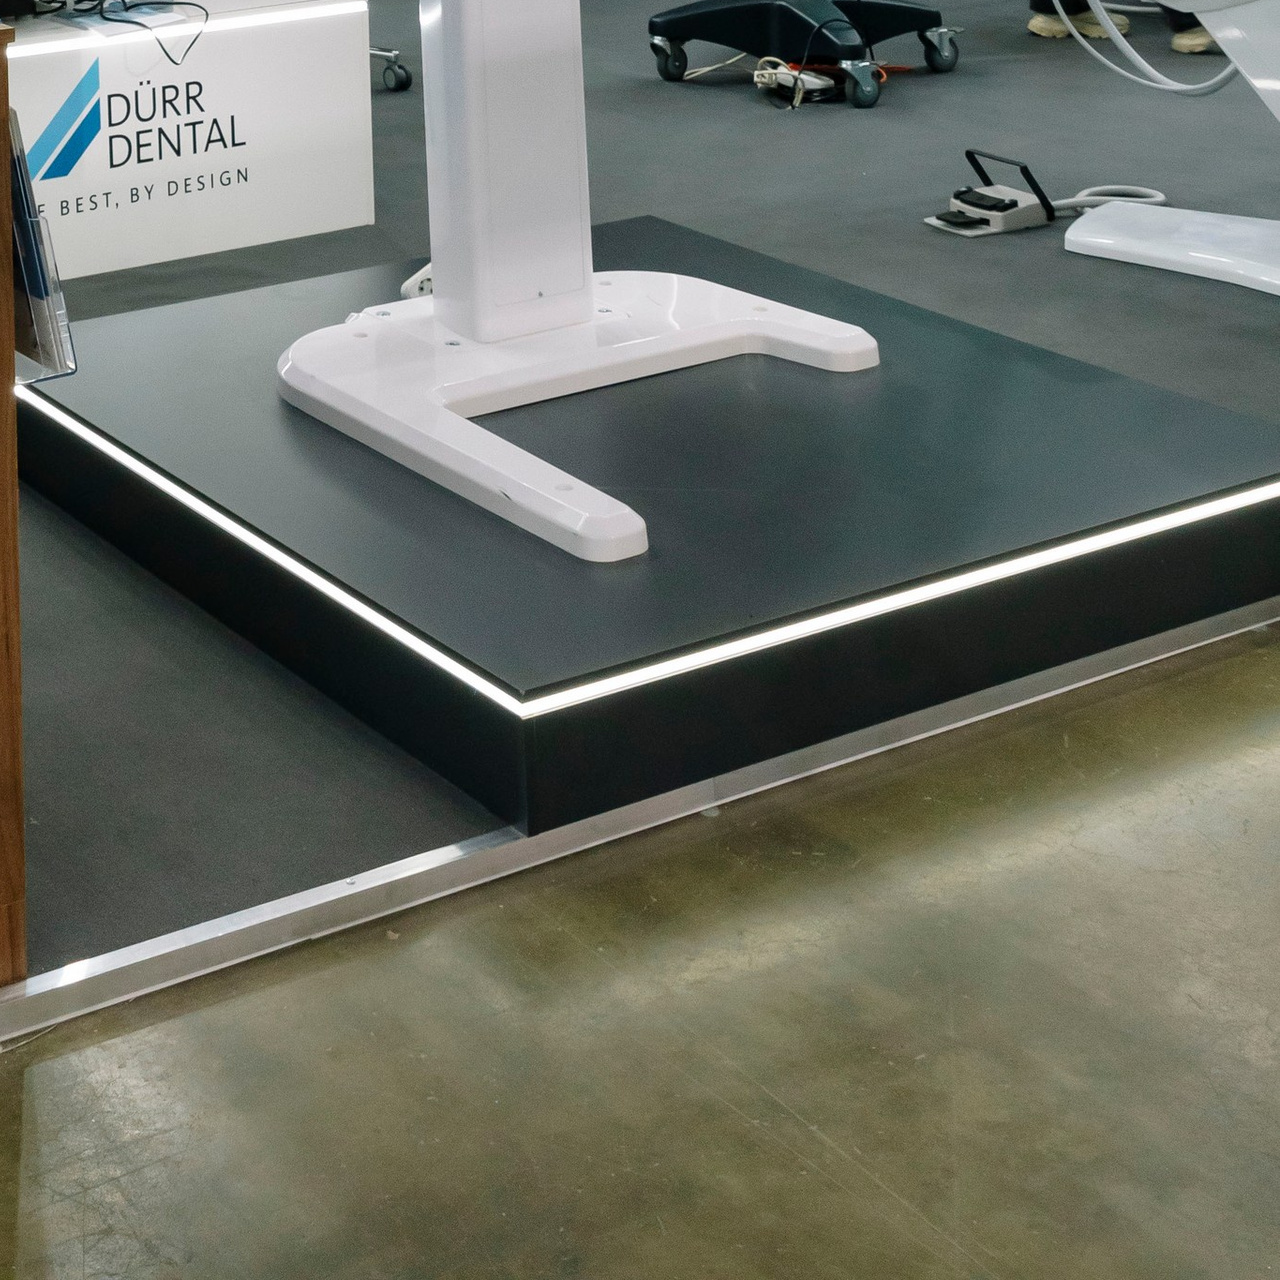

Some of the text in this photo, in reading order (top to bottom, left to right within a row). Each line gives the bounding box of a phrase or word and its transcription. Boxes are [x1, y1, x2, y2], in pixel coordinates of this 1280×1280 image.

[107, 80, 205, 128] DÜRR
[108, 115, 247, 169] DENTAL
[60, 192, 119, 216] BEST,
[130, 185, 154, 203] BY
[167, 167, 249, 196] DESIGN
